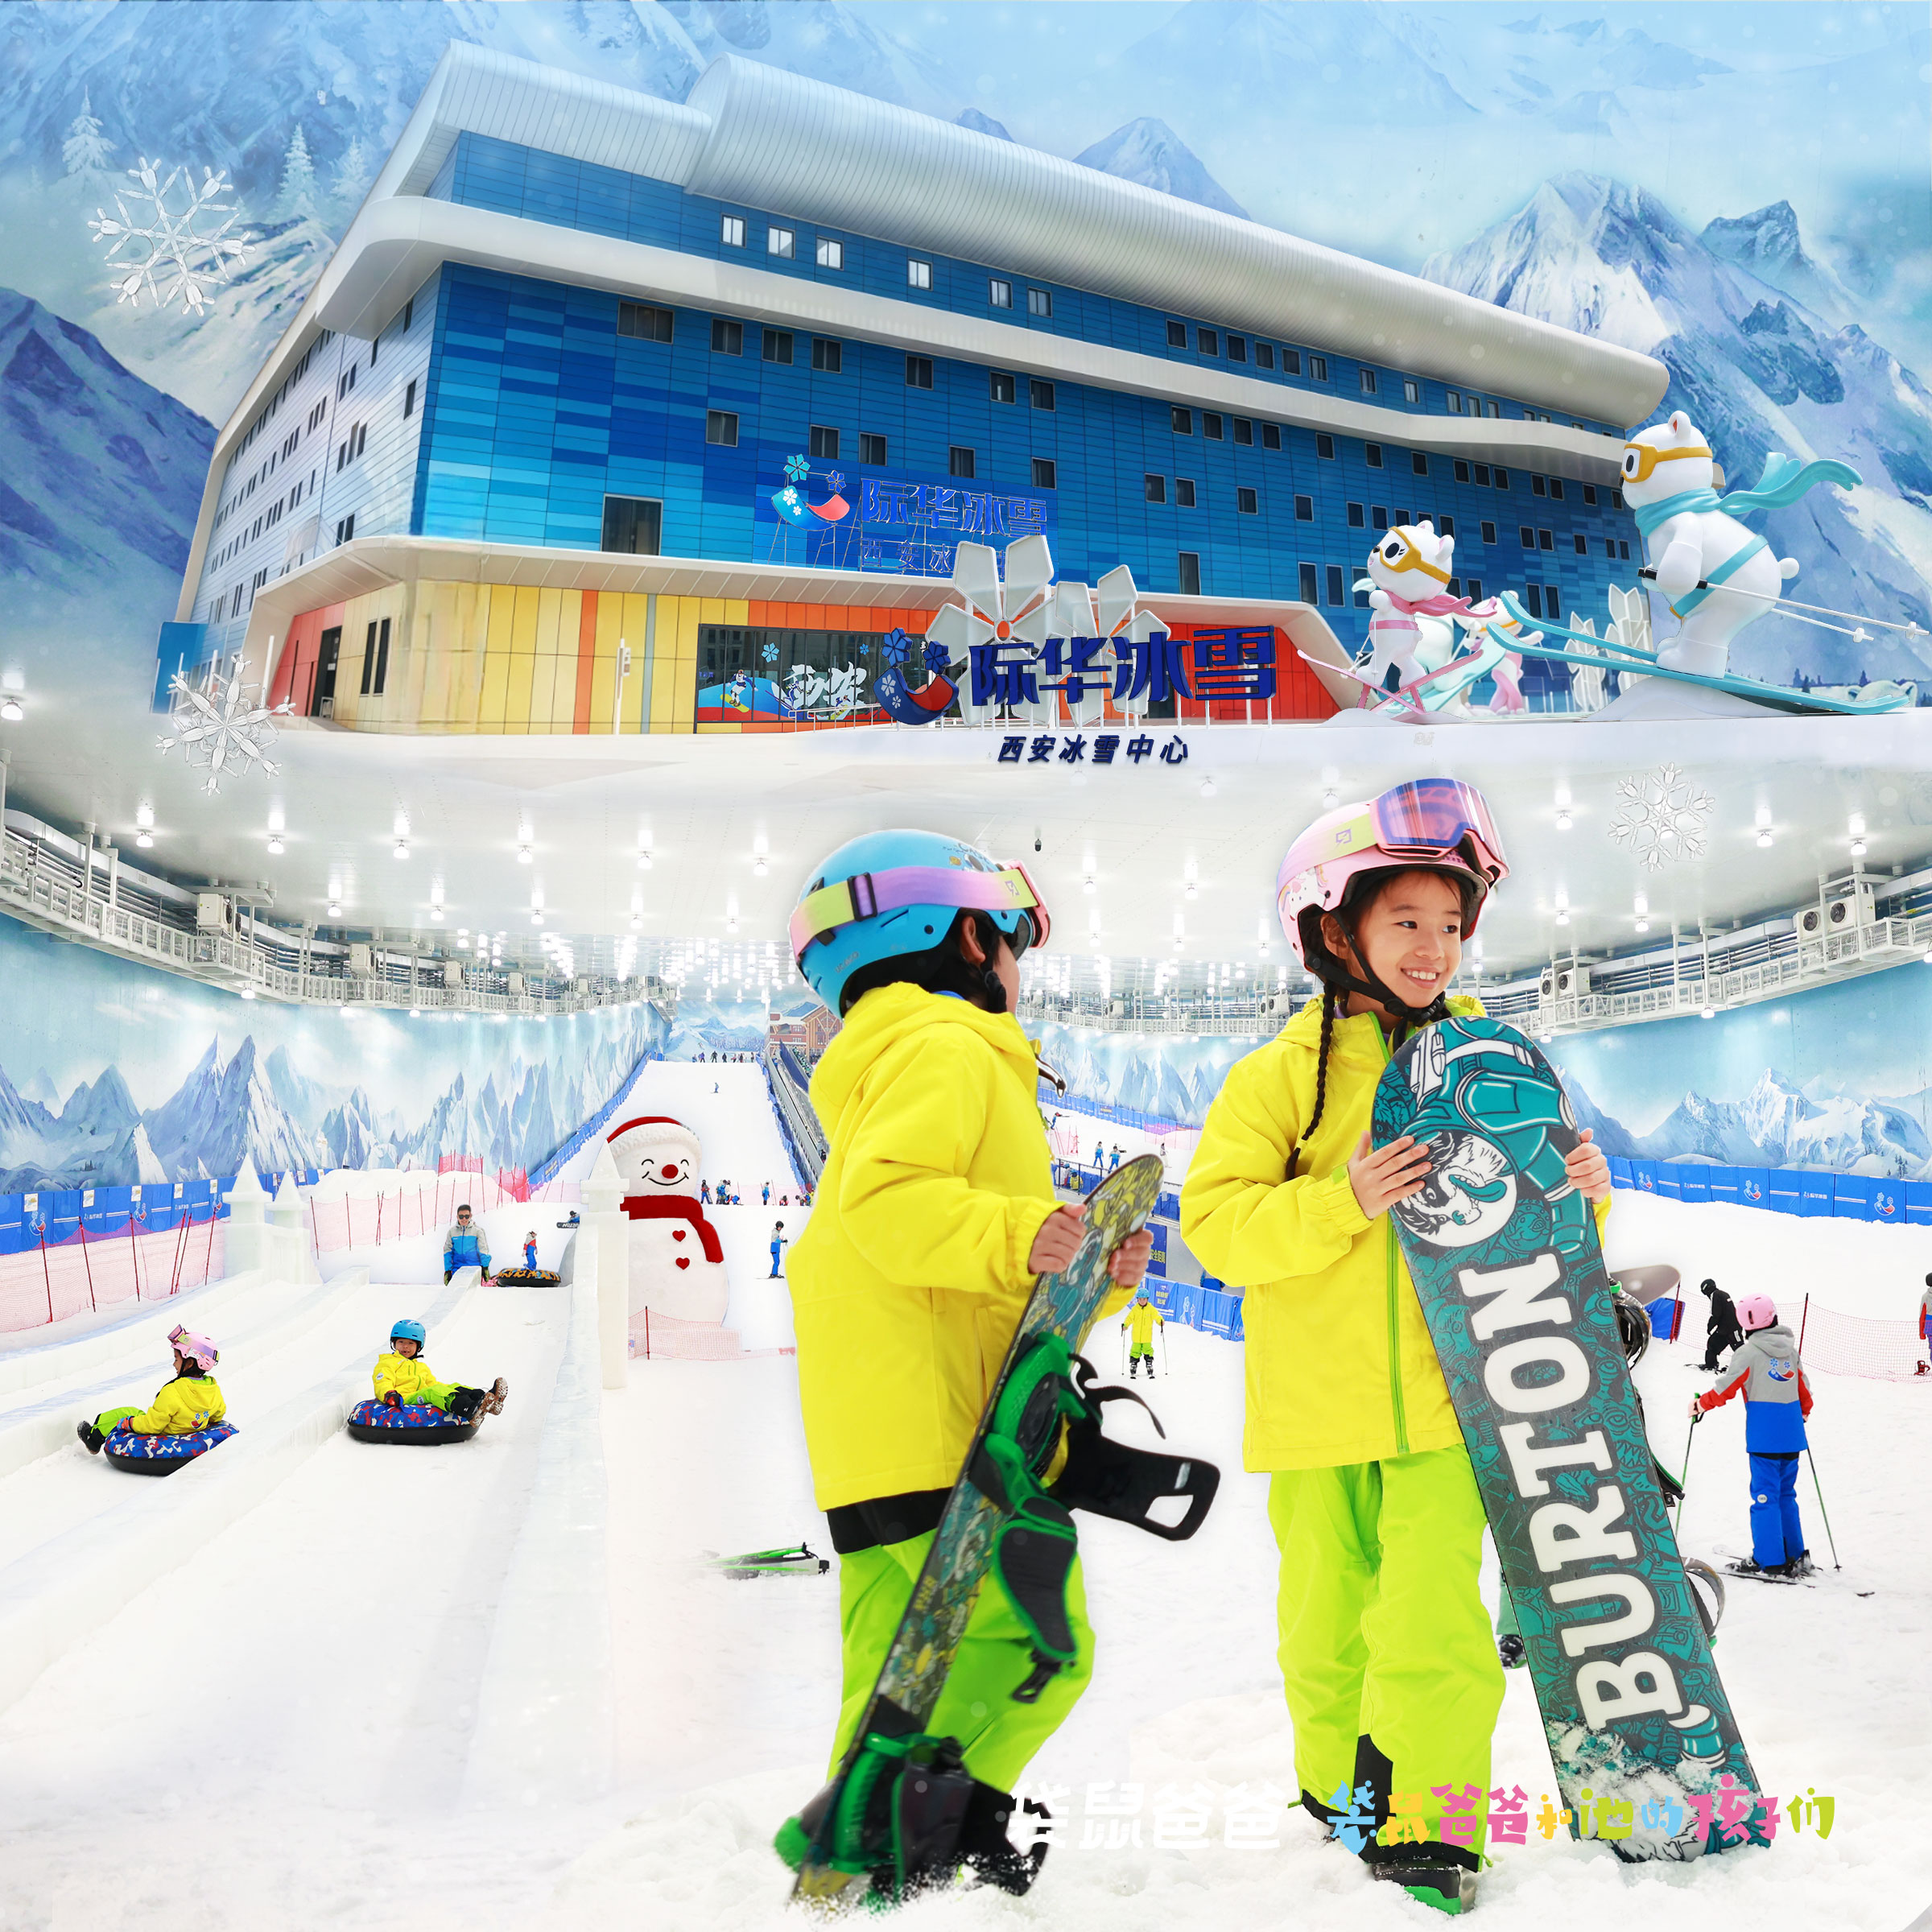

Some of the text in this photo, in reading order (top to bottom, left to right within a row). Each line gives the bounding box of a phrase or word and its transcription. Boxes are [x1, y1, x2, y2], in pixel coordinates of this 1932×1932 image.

[860, 477, 1047, 538] 际华冰雪
[968, 625, 1277, 707] 际华冰雪
[997, 733, 1190, 764] 西安冰雪中心
[1459, 1253, 1685, 1730] BURTON
